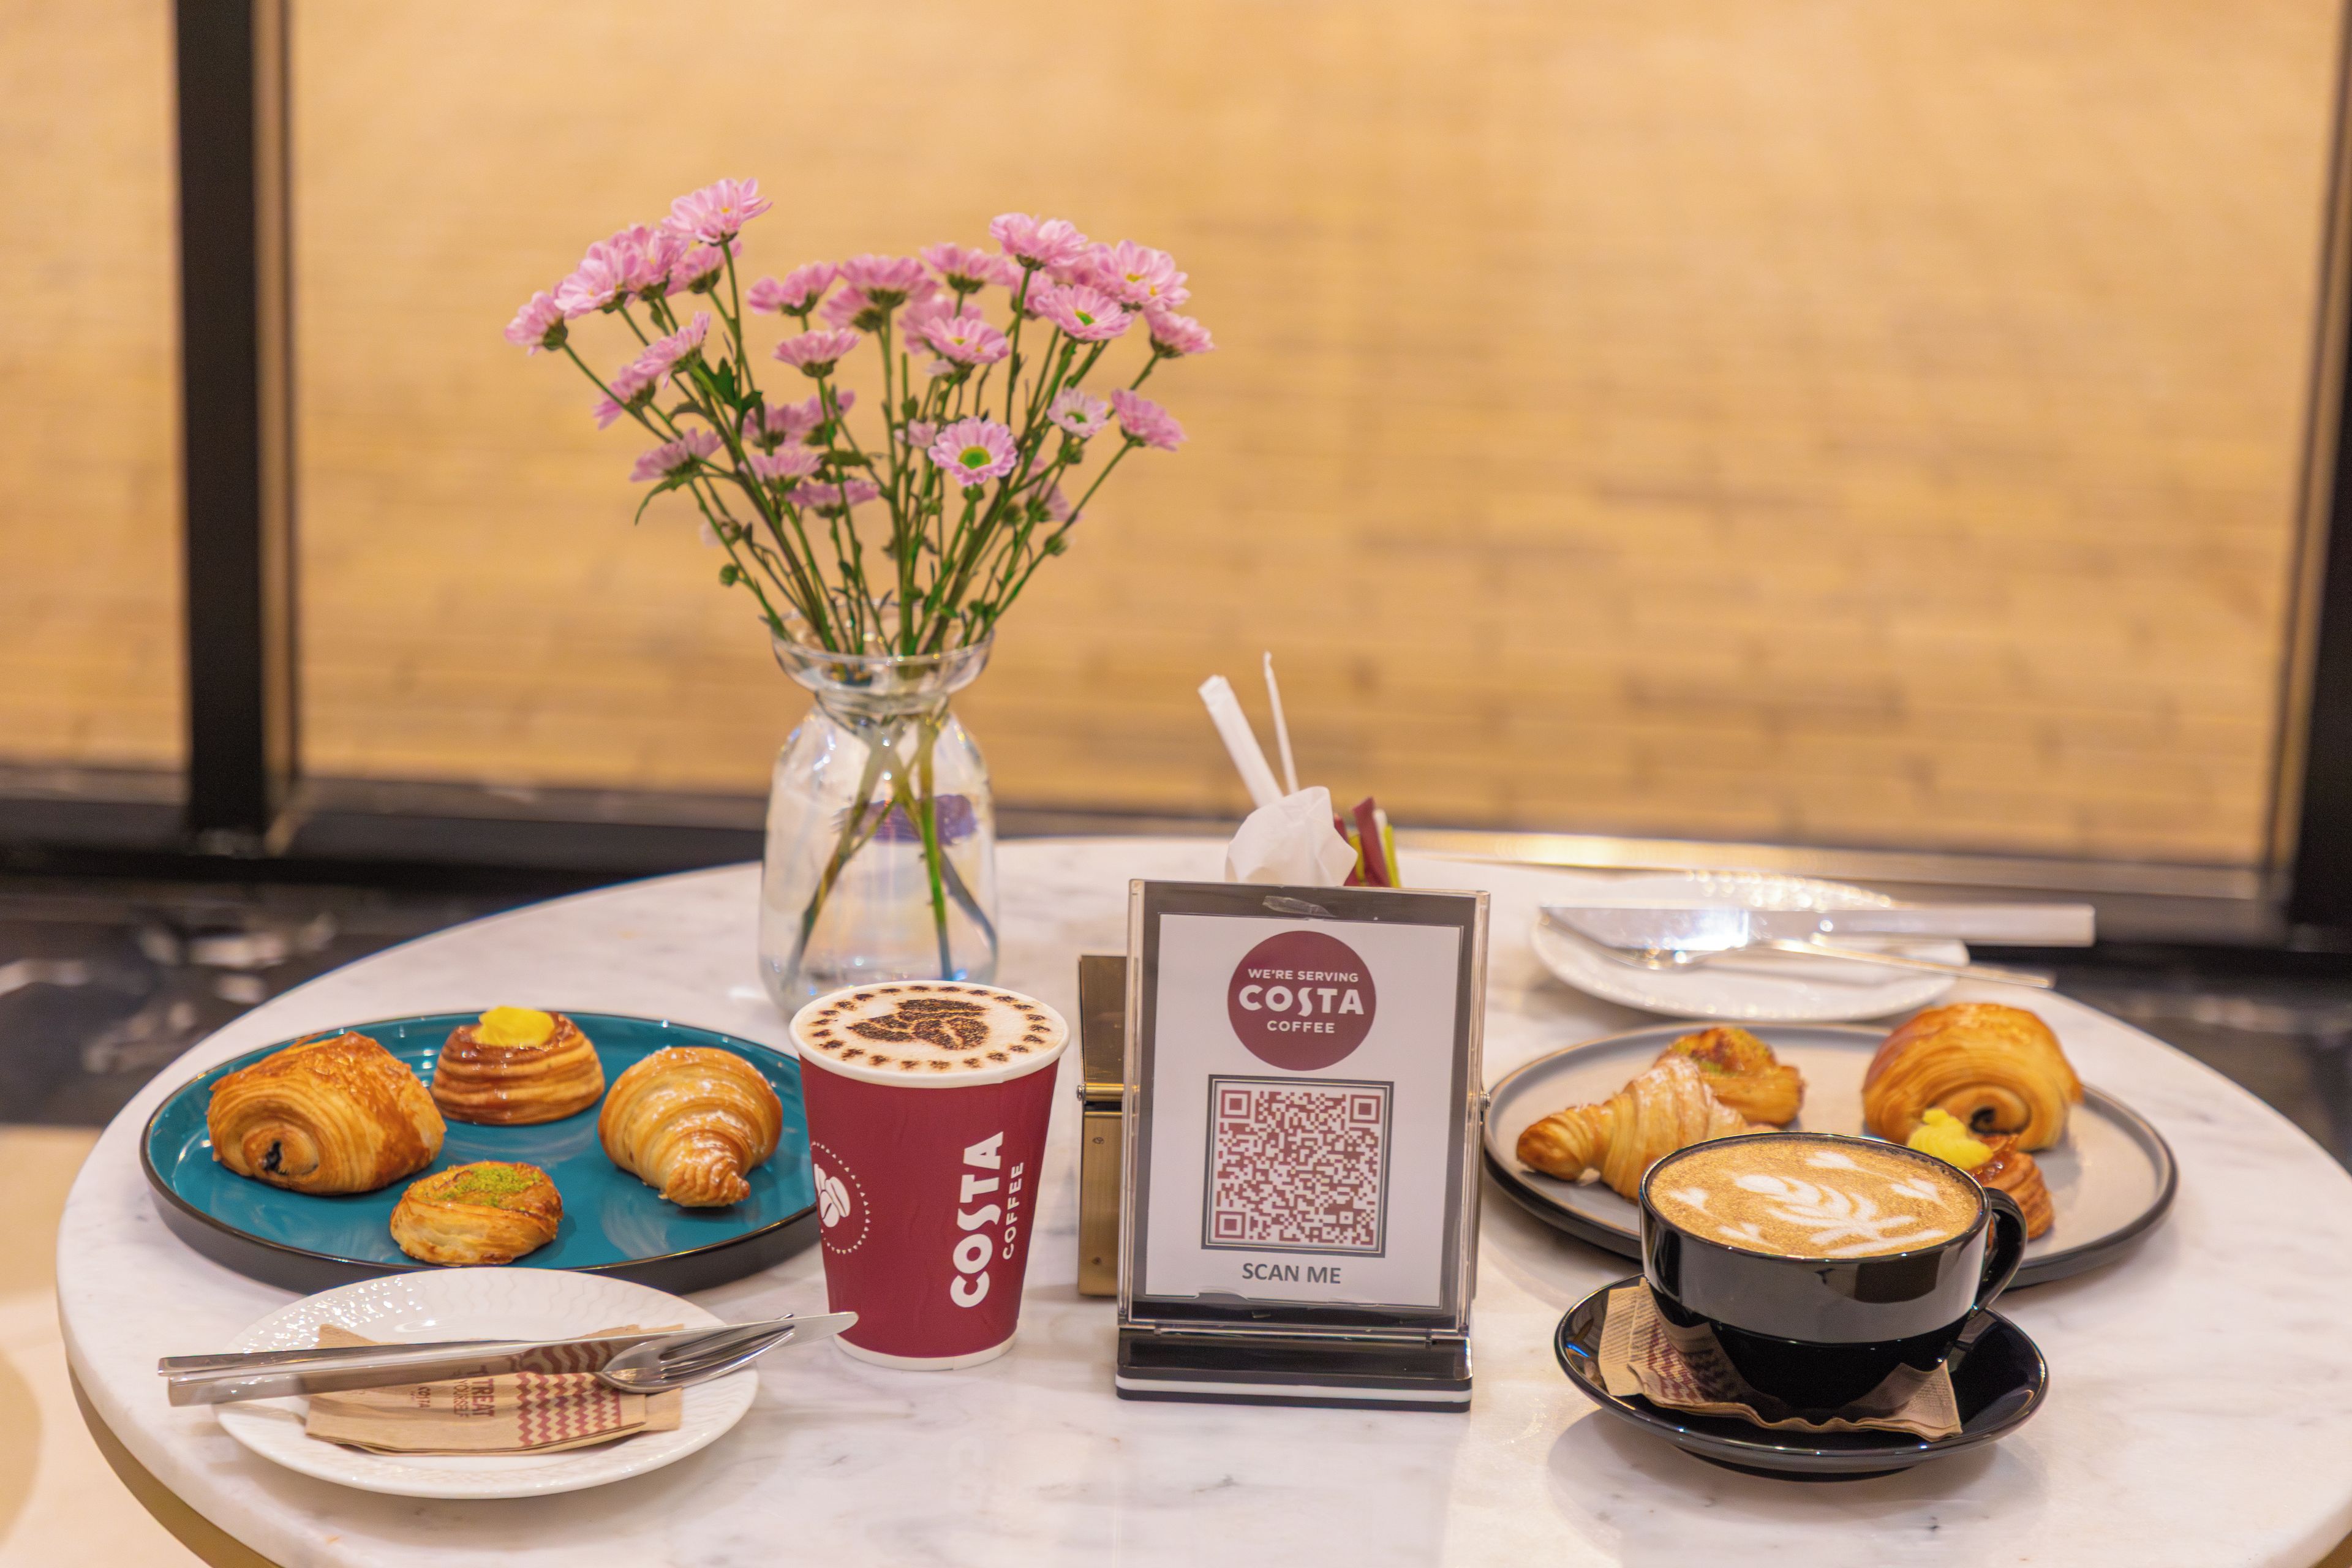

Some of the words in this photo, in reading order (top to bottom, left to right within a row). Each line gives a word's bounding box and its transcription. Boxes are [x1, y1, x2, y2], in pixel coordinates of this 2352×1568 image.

[1248, 968, 1293, 979] WE'RE
[1297, 971, 1359, 982] SERVING
[1239, 984, 1364, 1017] COSTA
[1267, 1020, 1335, 1033] COFFEE
[950, 1131, 1003, 1308] COSTA
[1003, 1162, 1023, 1259] COFFEE
[1242, 1262, 1300, 1284] SCAN
[1306, 1266, 1341, 1284] ME
[471, 1378, 494, 1417] TREAT
